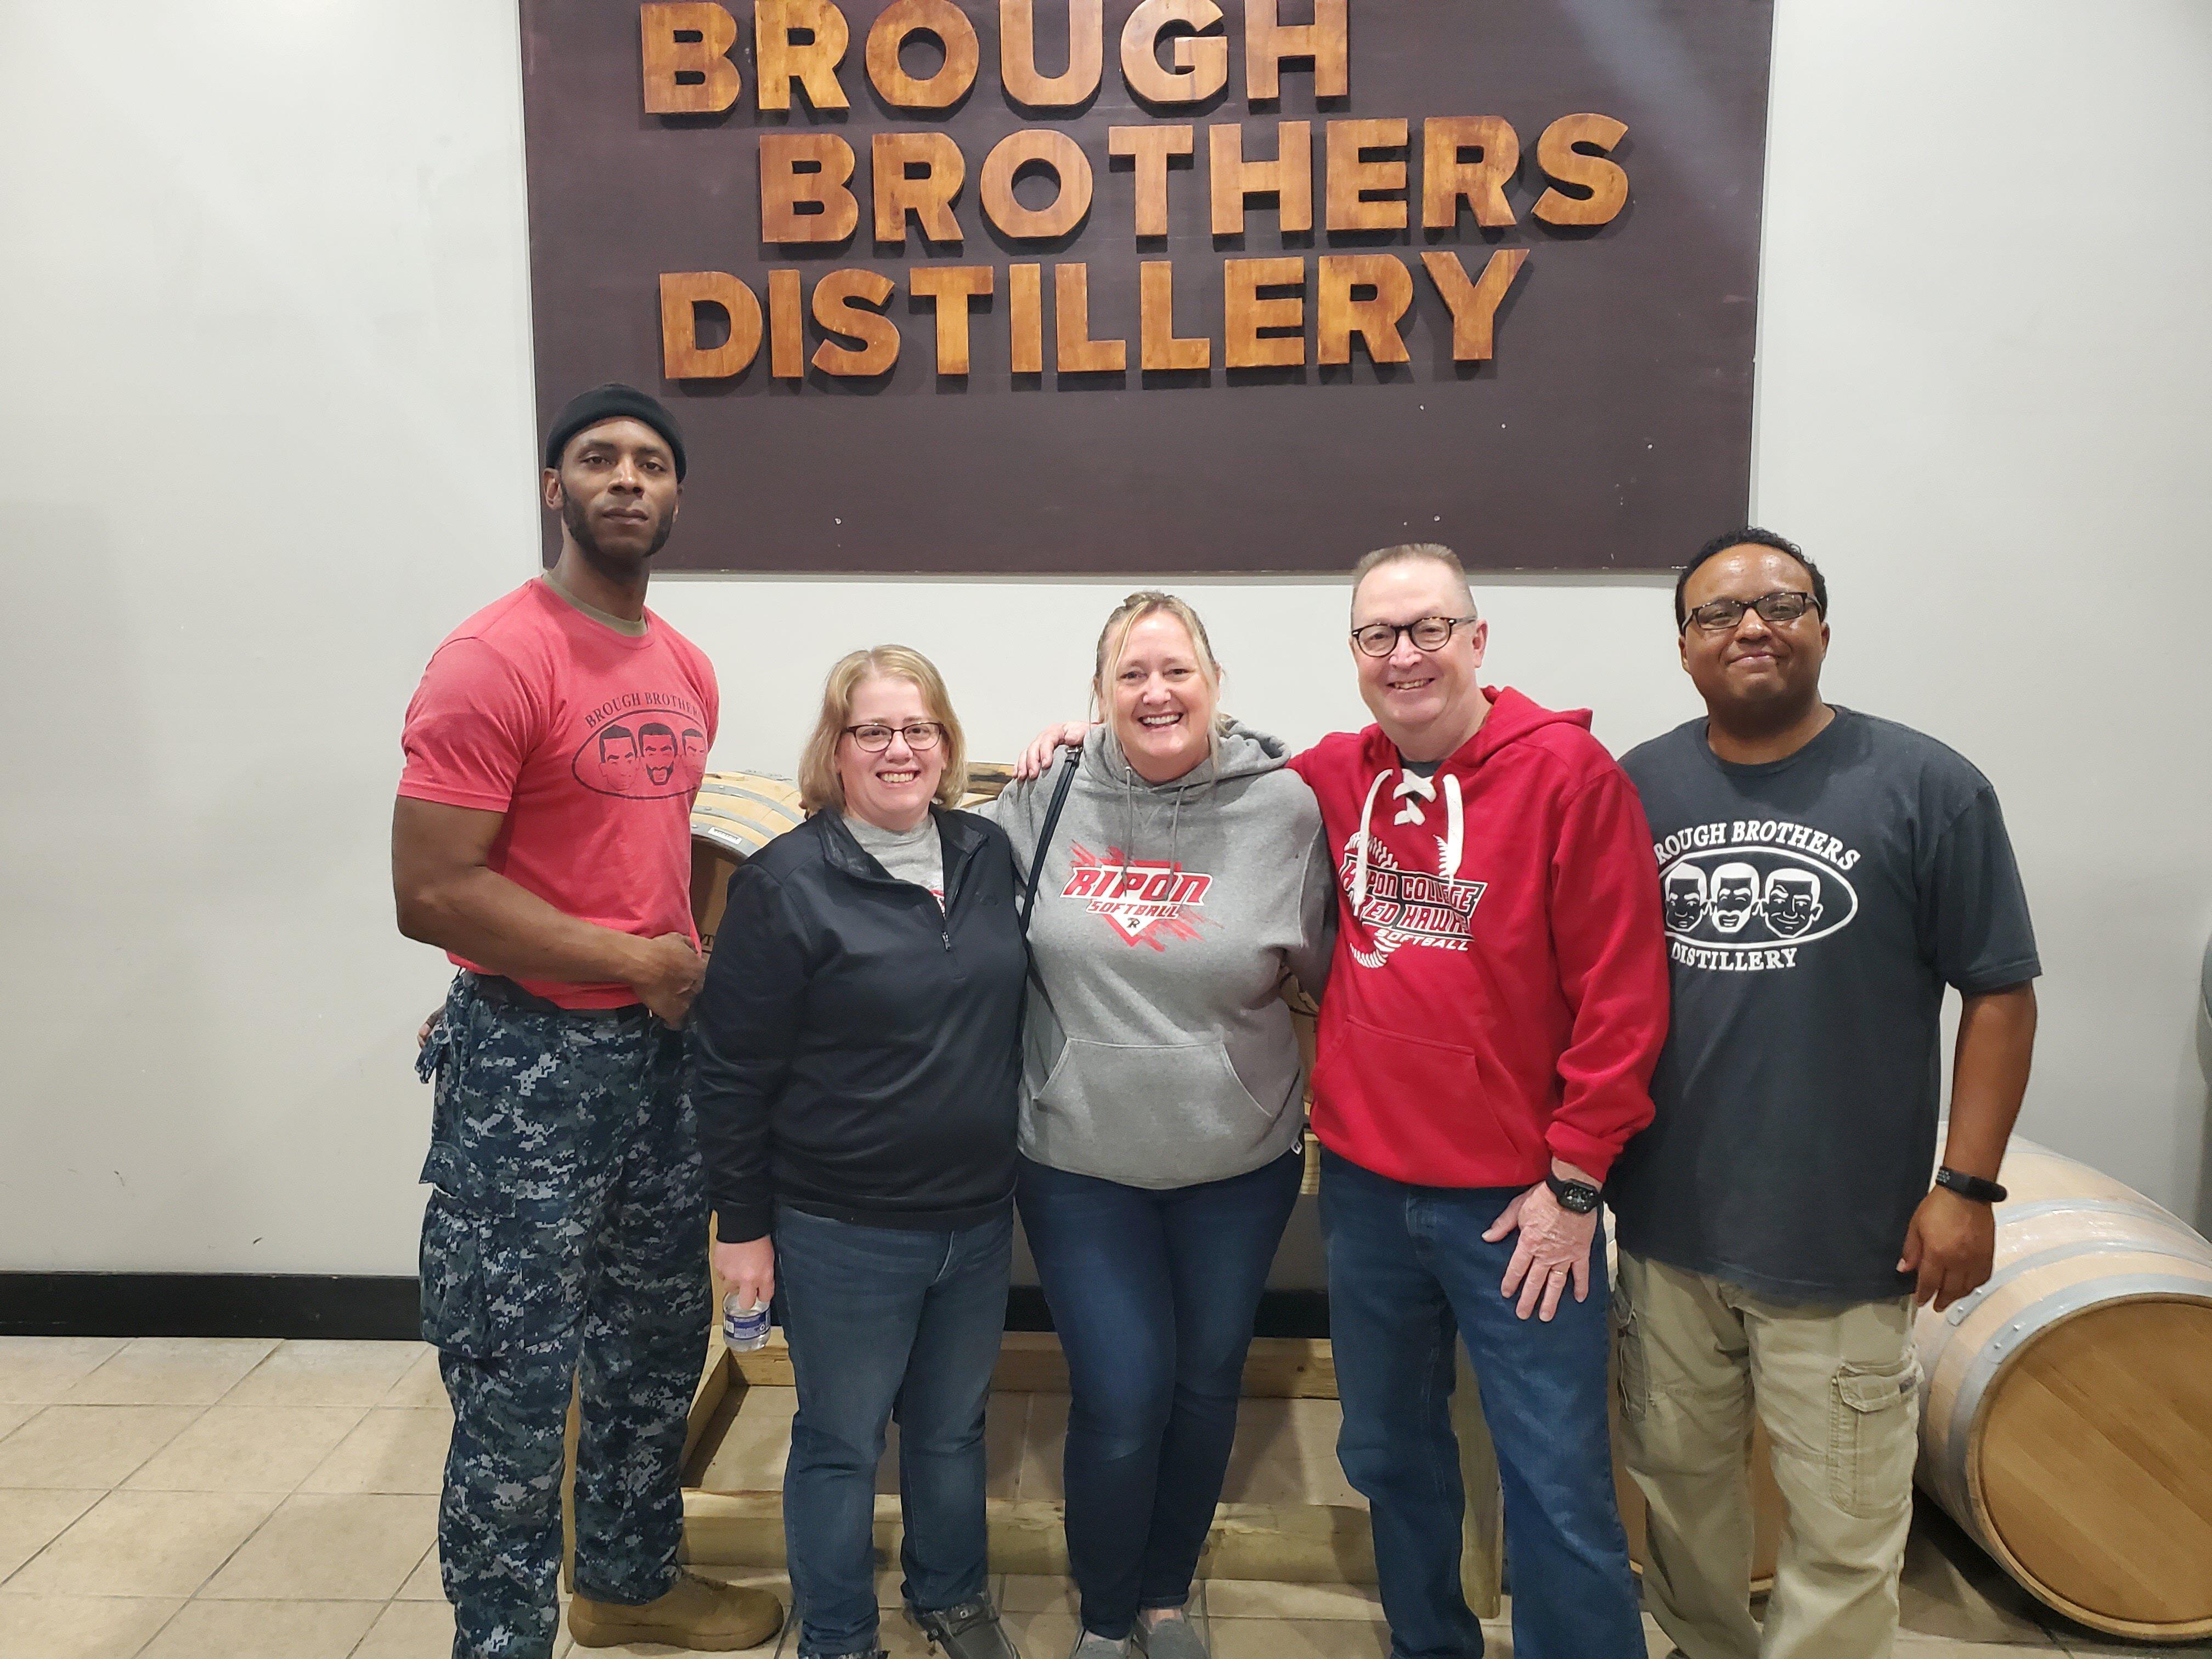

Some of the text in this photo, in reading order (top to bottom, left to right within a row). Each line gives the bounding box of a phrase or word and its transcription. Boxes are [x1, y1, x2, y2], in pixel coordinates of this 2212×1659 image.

[640, 0, 1348, 113] BROUGH
[760, 112, 1629, 244] BROTHERS
[659, 249, 1529, 379] DISTILLERY
[585, 692, 697, 728] BROUGH BROTHER
[1653, 821, 1861, 871] ROUGH BROTHERS
[1061, 868, 1212, 904] RIPON
[1340, 860, 1398, 899] RPON
[1087, 900, 1180, 918] SOFTBALL
[1374, 928, 1469, 951] SOFTBALL
[1671, 941, 1798, 971] DISTILLERY
